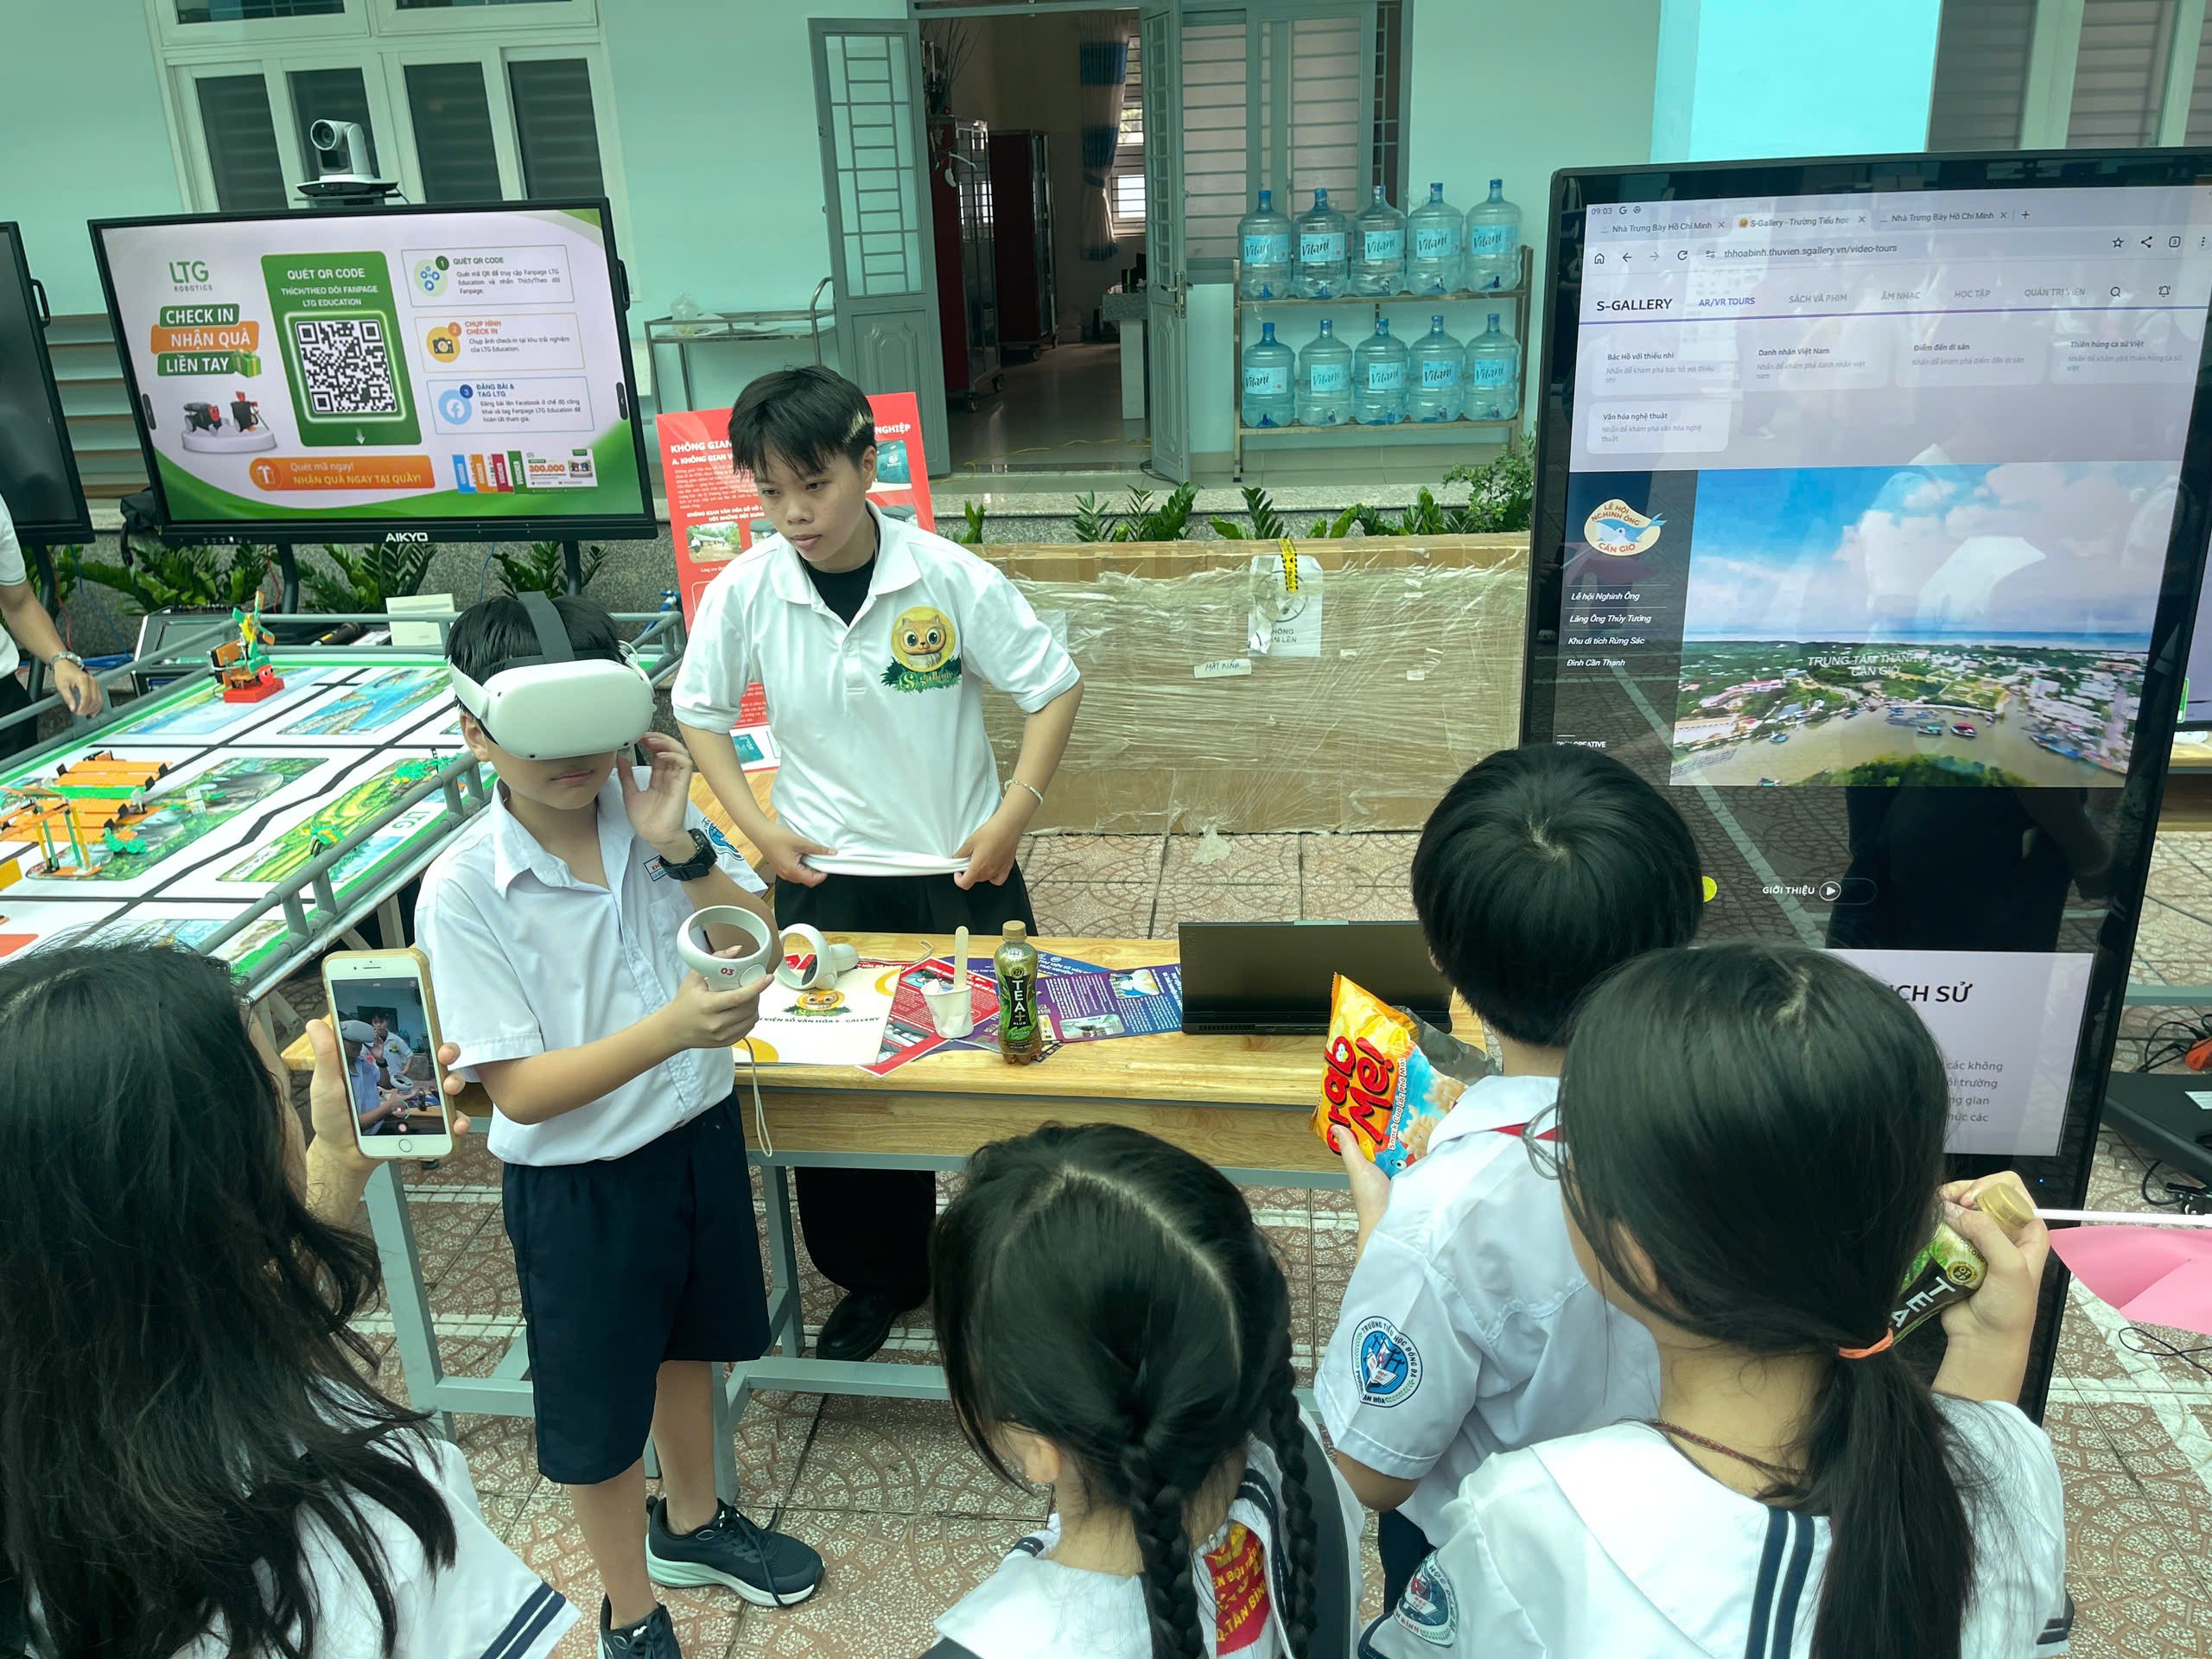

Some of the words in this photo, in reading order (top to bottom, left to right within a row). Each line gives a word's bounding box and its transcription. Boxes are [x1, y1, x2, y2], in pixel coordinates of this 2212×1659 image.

[1751, 218, 1783, 228] S-Gallery
[1789, 217, 1814, 227] Trường
[1815, 216, 1833, 225] Tiểu
[1834, 217, 1849, 226] học
[1892, 213, 1907, 222] Nhà
[1909, 213, 1931, 223] Trưng
[1933, 213, 1948, 221] Bày
[1949, 211, 1961, 220] Hồ
[1612, 225, 1627, 233] Nhà
[1629, 225, 1649, 234] Trưng
[1652, 224, 1667, 232] Bày
[1669, 222, 1679, 231] Hồ
[1681, 221, 1692, 230] Chí
[1367, 238, 1395, 254] Vitani
[1419, 236, 1447, 251] Vitani
[1473, 232, 1501, 250] Vitani
[1302, 239, 1329, 257] Vitani
[1724, 243, 1897, 258] thhoabinh.thuvien.sgallery.vn/video-tours
[168, 261, 208, 283] LTG
[288, 268, 315, 280] QUÉT
[318, 269, 333, 278] QR
[335, 268, 365, 278] CODE
[281, 287, 327, 296] THÍCH/THEO
[343, 285, 378, 294] FANPAGE
[1974, 288, 1991, 299] TẬP
[2066, 288, 2085, 296] VIÊN
[1699, 297, 1726, 307] AR/VR
[1727, 296, 1755, 305] TOURS
[1789, 293, 1811, 303] SÁCH
[1813, 292, 1823, 302] VÀ
[1826, 293, 1847, 302] PHIM
[1597, 298, 1672, 312] S-GALLERY
[166, 308, 213, 324] CHECK
[218, 308, 233, 321] IN
[171, 329, 213, 349] NHẬN
[219, 327, 251, 348] QUÀ
[1608, 353, 1621, 361] Bác
[1796, 346, 1811, 355] Việt
[166, 355, 198, 372] LIỀN
[202, 357, 229, 372] TAY
[1313, 372, 1339, 386] Vitani
[1371, 370, 1398, 385] Vitani
[1424, 365, 1452, 383] Vitani
[1476, 365, 1503, 380] Vitani
[874, 422, 911, 434] NGHIỆP
[671, 441, 705, 453] KHÔNG
[708, 440, 732, 449] GIAN
[681, 455, 707, 464] KHÔNG
[290, 462, 313, 472] Quét
[330, 462, 353, 474] ngay!
[324, 474, 346, 485] QUÀ
[346, 475, 372, 484] NGAY
[374, 475, 391, 486] TẠI
[1604, 503, 1613, 512] LỄ
[1615, 505, 1630, 514] HỘI
[1591, 512, 1622, 523] NGHINH
[1624, 512, 1639, 526] ÔNG
[385, 532, 429, 543] AIKYO
[1599, 541, 1617, 553] CẦN
[1619, 543, 1636, 553] GIỜ
[1582, 593, 1593, 601] hội
[1596, 593, 1622, 601] Nghinh
[1624, 591, 1640, 601] Ông
[1590, 614, 1605, 624] Ông
[1607, 614, 1626, 623] Thủy
[1609, 637, 1629, 645] Rừng
[1808, 656, 1850, 668] TRUNG
[1763, 885, 1783, 894] GIỚI
[1785, 885, 1815, 896] THIỆU
[1936, 981, 1973, 1002] SỬ
[1947, 1060, 1965, 1070] các
[1968, 1061, 2003, 1072] không
[1349, 1036, 1395, 1145] Me!
[1961, 1078, 1997, 1090] trường
[1396, 1092, 1406, 1107] Lắc
[1966, 1096, 1989, 1106] gian
[1393, 1107, 1402, 1123] Cua
[1970, 1113, 1989, 1122] các
[1389, 1124, 1400, 1152] Snack
[1891, 1275, 1956, 1327] TEA
[1361, 1320, 1382, 1333] TRƯỜNG
[1383, 1323, 1394, 1337] TIỂU
[1394, 1335, 1407, 1347] HỌC
[1407, 1346, 1417, 1368] ĐỐNG
[1227, 1565, 1245, 1581] ĐỘI
[1429, 1565, 1446, 1585] HỌC
[1226, 1605, 1249, 1632] TÂN
